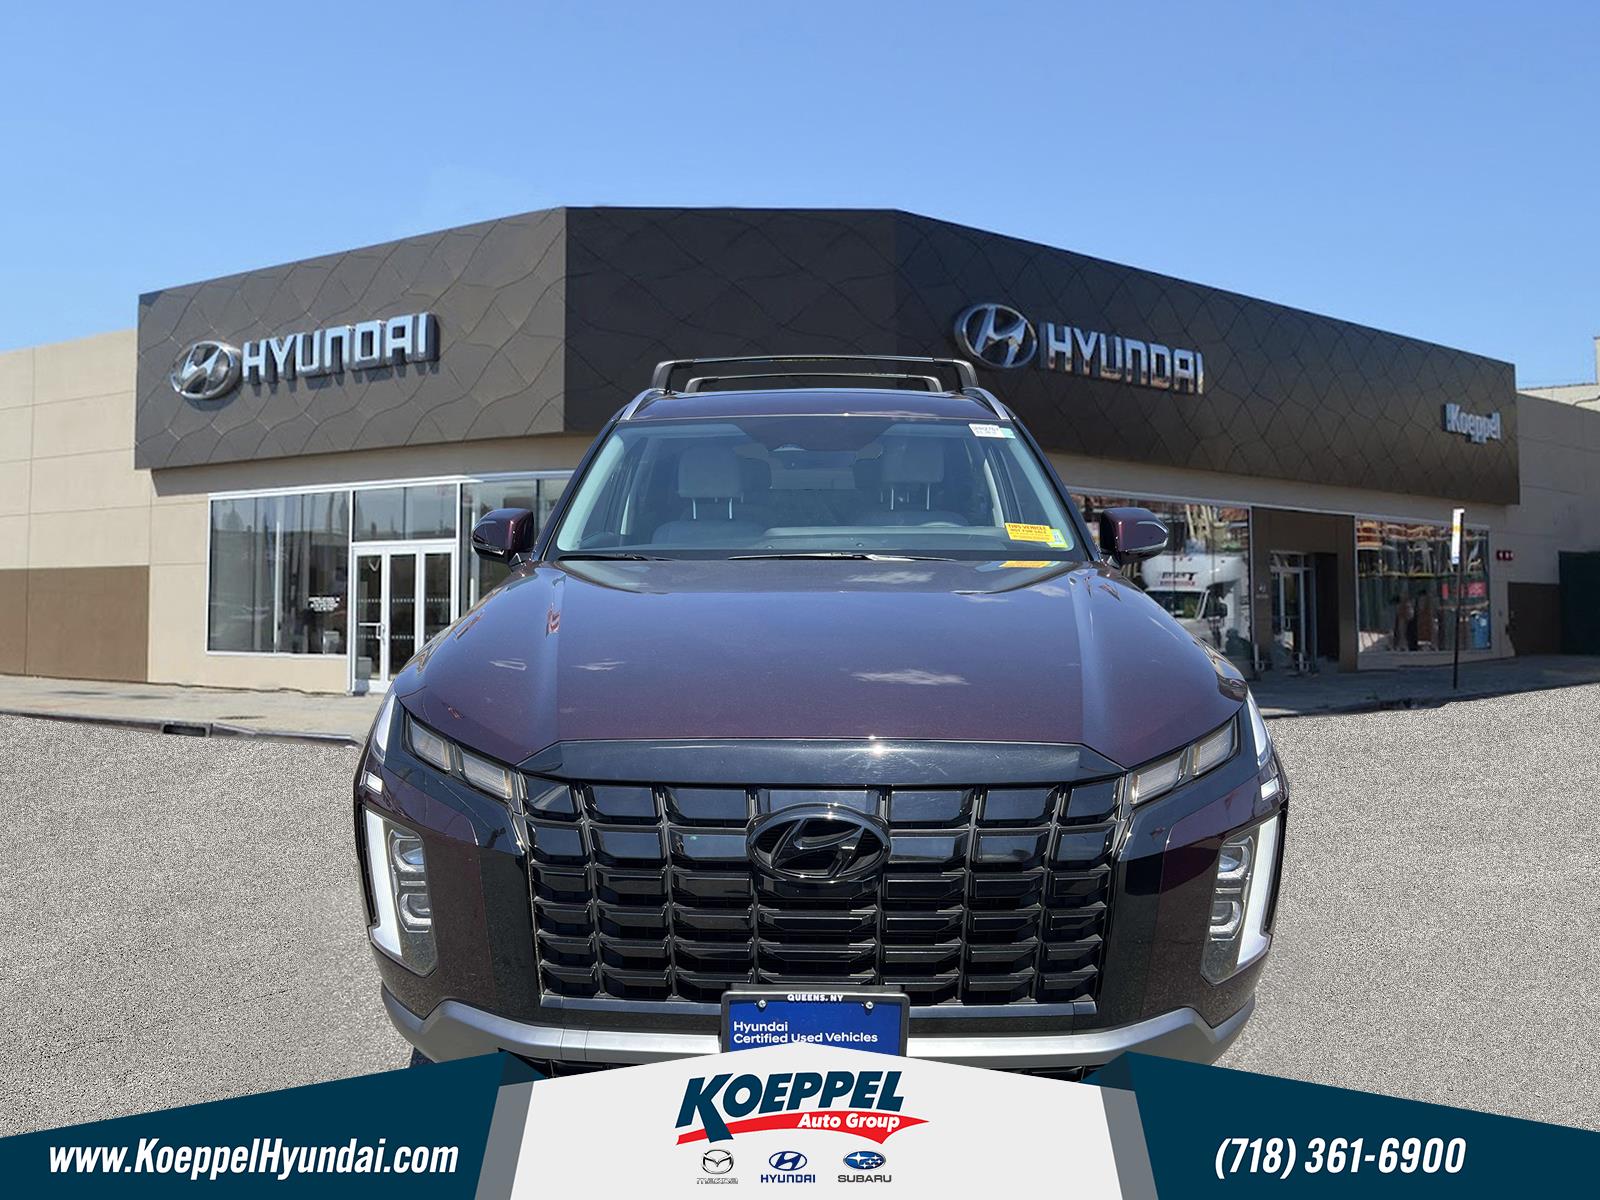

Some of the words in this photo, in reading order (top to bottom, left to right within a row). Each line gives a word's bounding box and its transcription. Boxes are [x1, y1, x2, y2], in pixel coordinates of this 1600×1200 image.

[242, 312, 433, 381] HYUNDAI
[1046, 322, 1205, 394] HYUNDAI
[1444, 403, 1502, 443] Koeppel
[830, 994, 844, 1002] NY
[733, 1021, 788, 1034] Hyundai
[733, 1034, 788, 1044] Certified
[791, 1033, 823, 1043] Used
[825, 1032, 878, 1043] Vehicles
